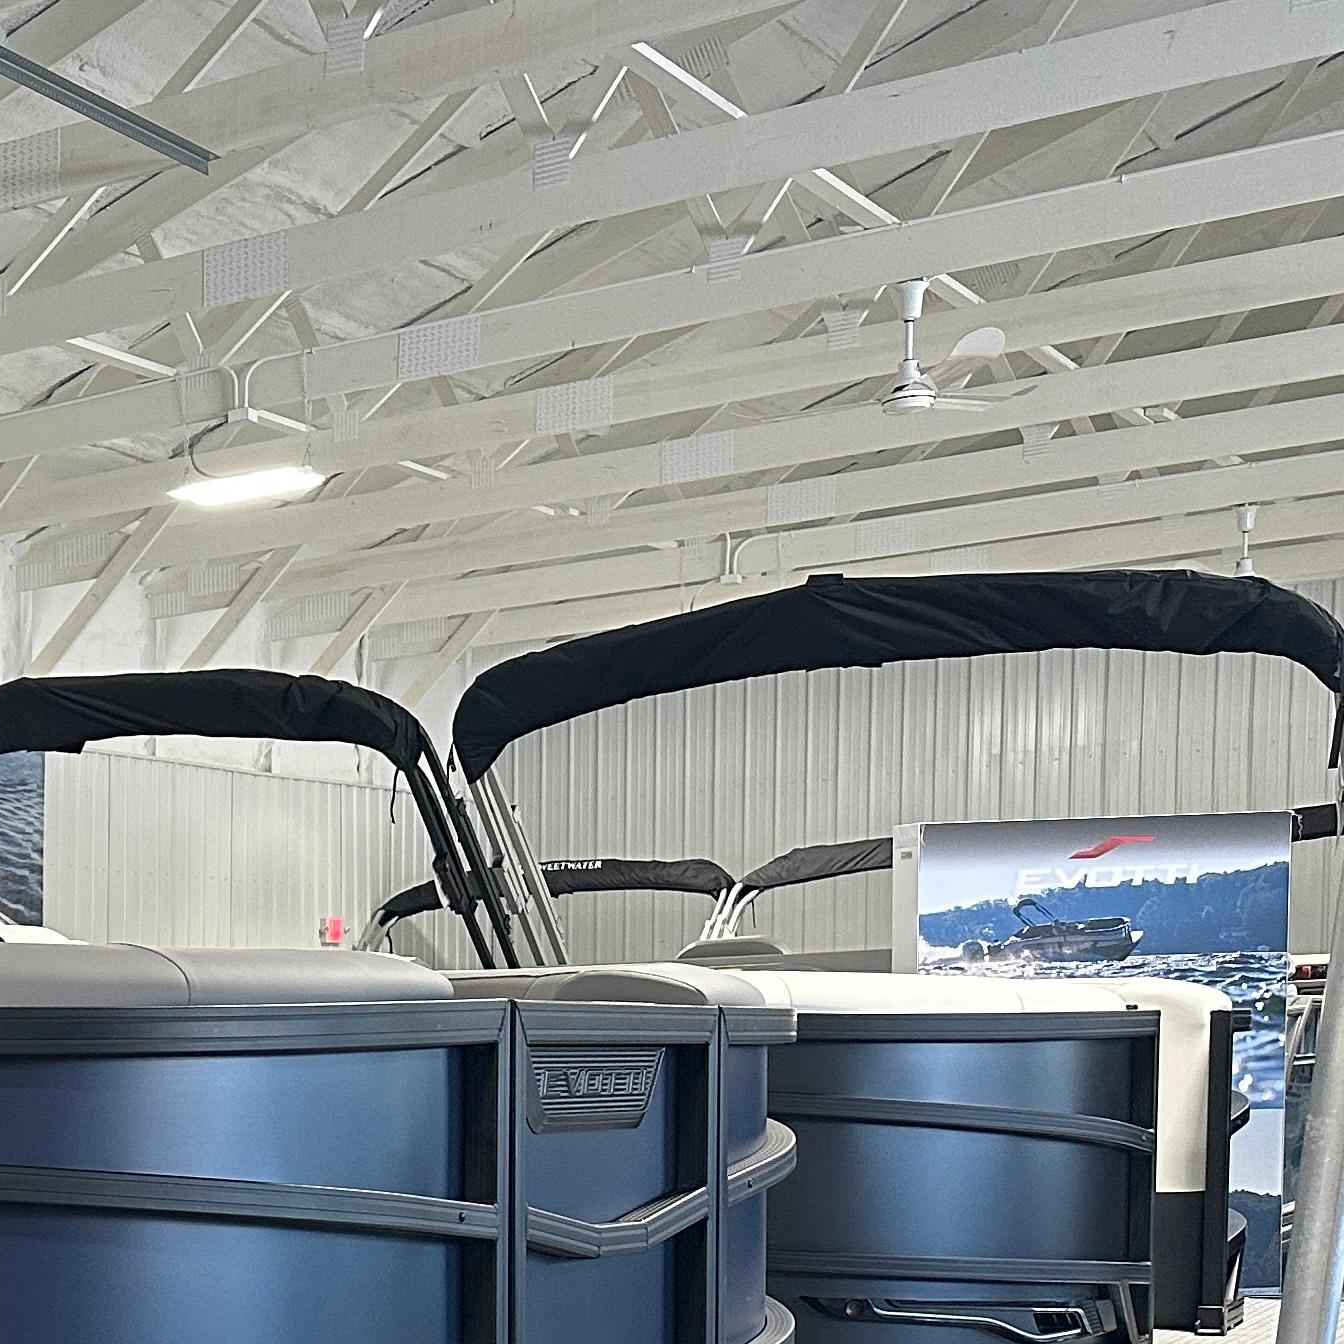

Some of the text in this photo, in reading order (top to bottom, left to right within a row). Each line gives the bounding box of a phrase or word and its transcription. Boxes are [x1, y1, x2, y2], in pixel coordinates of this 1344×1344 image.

[538, 861, 602, 871] WEETWATER
[1015, 863, 1201, 890] EVOTTI
[540, 1067, 647, 1098] EVOTTI
